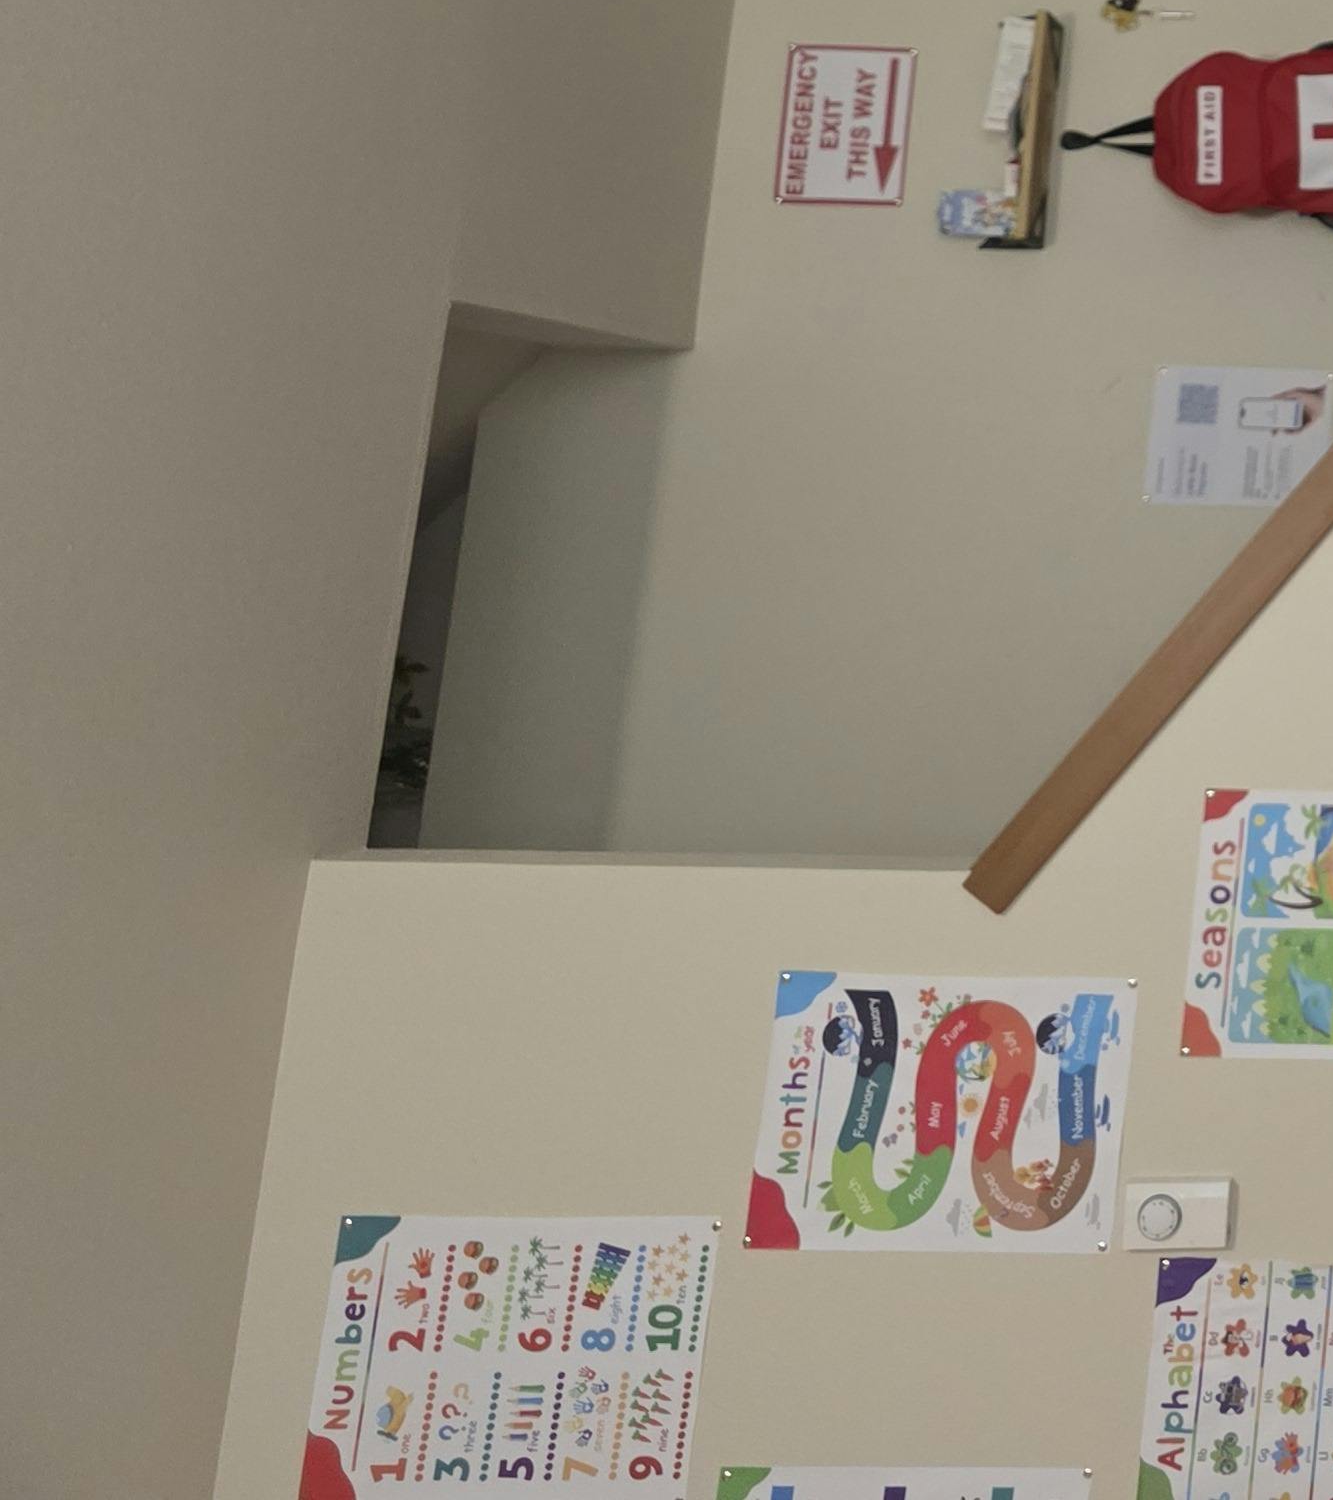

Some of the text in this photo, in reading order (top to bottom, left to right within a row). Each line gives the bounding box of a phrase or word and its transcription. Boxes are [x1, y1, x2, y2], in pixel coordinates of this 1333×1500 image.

[785, 49, 818, 194] EMERGENCY
[819, 97, 843, 149] EXIT
[845, 67, 877, 180] THIS WAY
[1203, 91, 1216, 178] FIRST AID
[1195, 839, 1236, 988] Seasons
[868, 997, 885, 1046] January
[941, 1018, 968, 1046] June
[1002, 1030, 1022, 1056] July
[1071, 996, 1096, 1059] December
[776, 1056, 810, 1173] Months
[853, 1078, 878, 1138] February
[928, 1100, 942, 1127] May
[989, 1095, 1010, 1139] August
[1071, 1073, 1085, 1139] November
[847, 1177, 873, 1214] March
[907, 1173, 931, 1204] April
[983, 1170, 1036, 1217] September
[1049, 1157, 1081, 1208] October
[323, 1267, 373, 1428] Numbers
[388, 1302, 431, 1351] 2 two
[453, 1327, 490, 1350] 4
[518, 1307, 557, 1352] 6 six
[581, 1294, 623, 1351] 8 eight
[646, 1303, 683, 1351] 10
[1156, 1305, 1198, 1470] Alphabet
[371, 1432, 412, 1481] 1 one
[433, 1419, 478, 1481] 3 three
[498, 1429, 541, 1480] 5 five
[562, 1455, 599, 1480] 7
[628, 1427, 670, 1479] 9 nine
